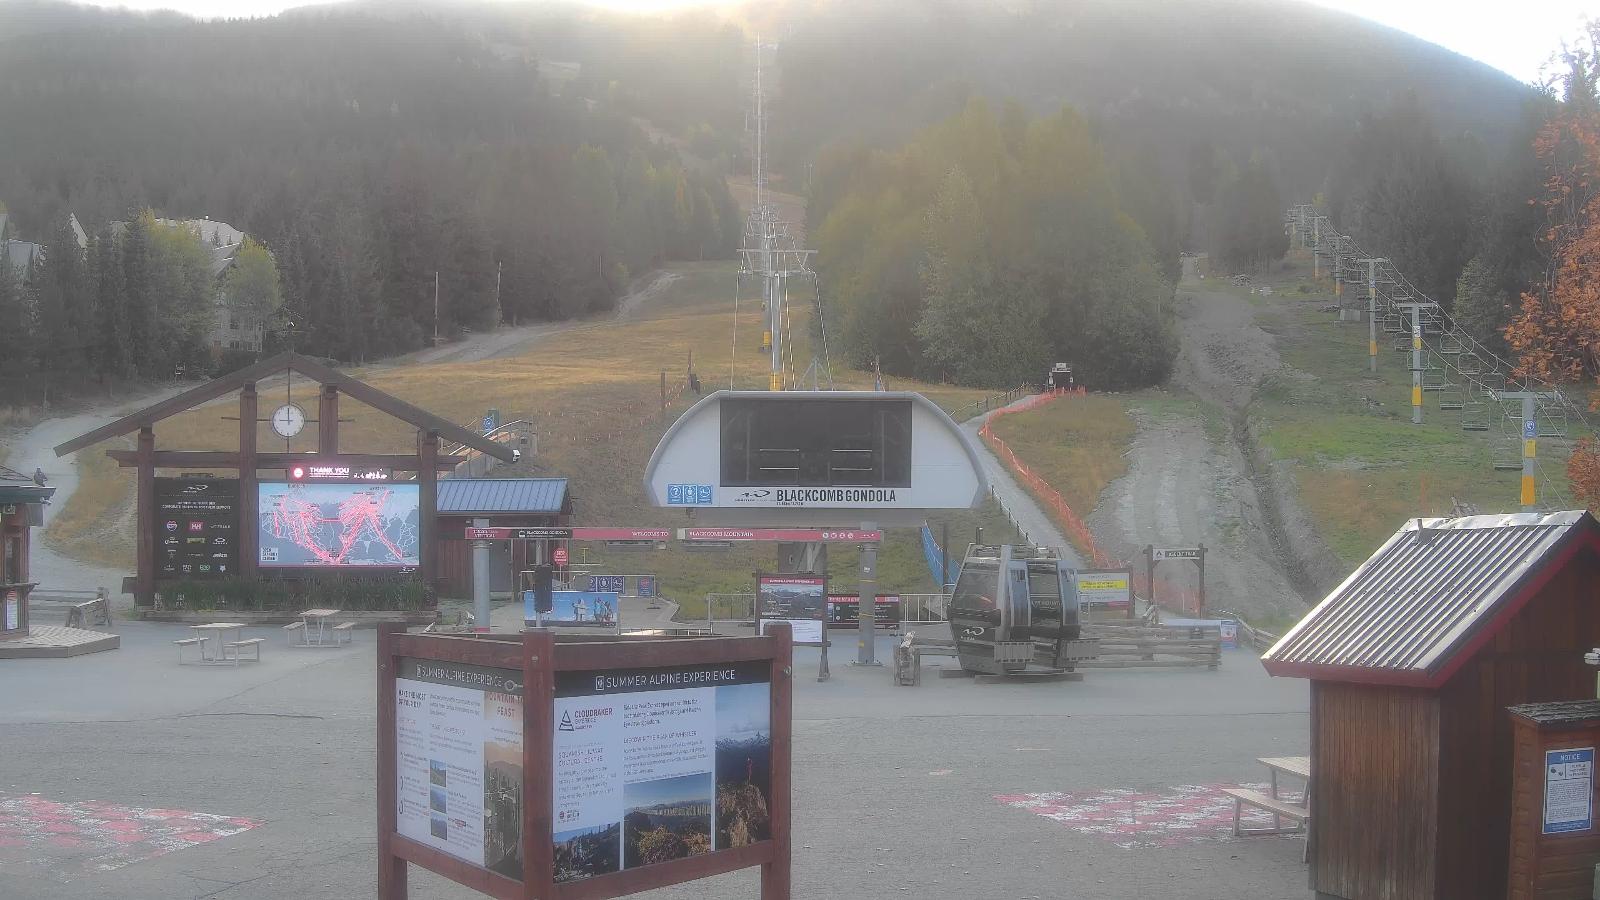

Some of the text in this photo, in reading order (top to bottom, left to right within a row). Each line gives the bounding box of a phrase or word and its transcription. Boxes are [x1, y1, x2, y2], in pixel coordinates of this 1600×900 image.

[776, 489, 896, 502] BLACKCOMB GONDOLA
[466, 672, 503, 687] EXPERIENCE
[606, 669, 736, 688] SUMMER ALPINE EXPERIENCE
[496, 706, 516, 717] FEAST
[574, 707, 614, 718] CLOUDRAKER
[1560, 753, 1580, 762] NOTICE
